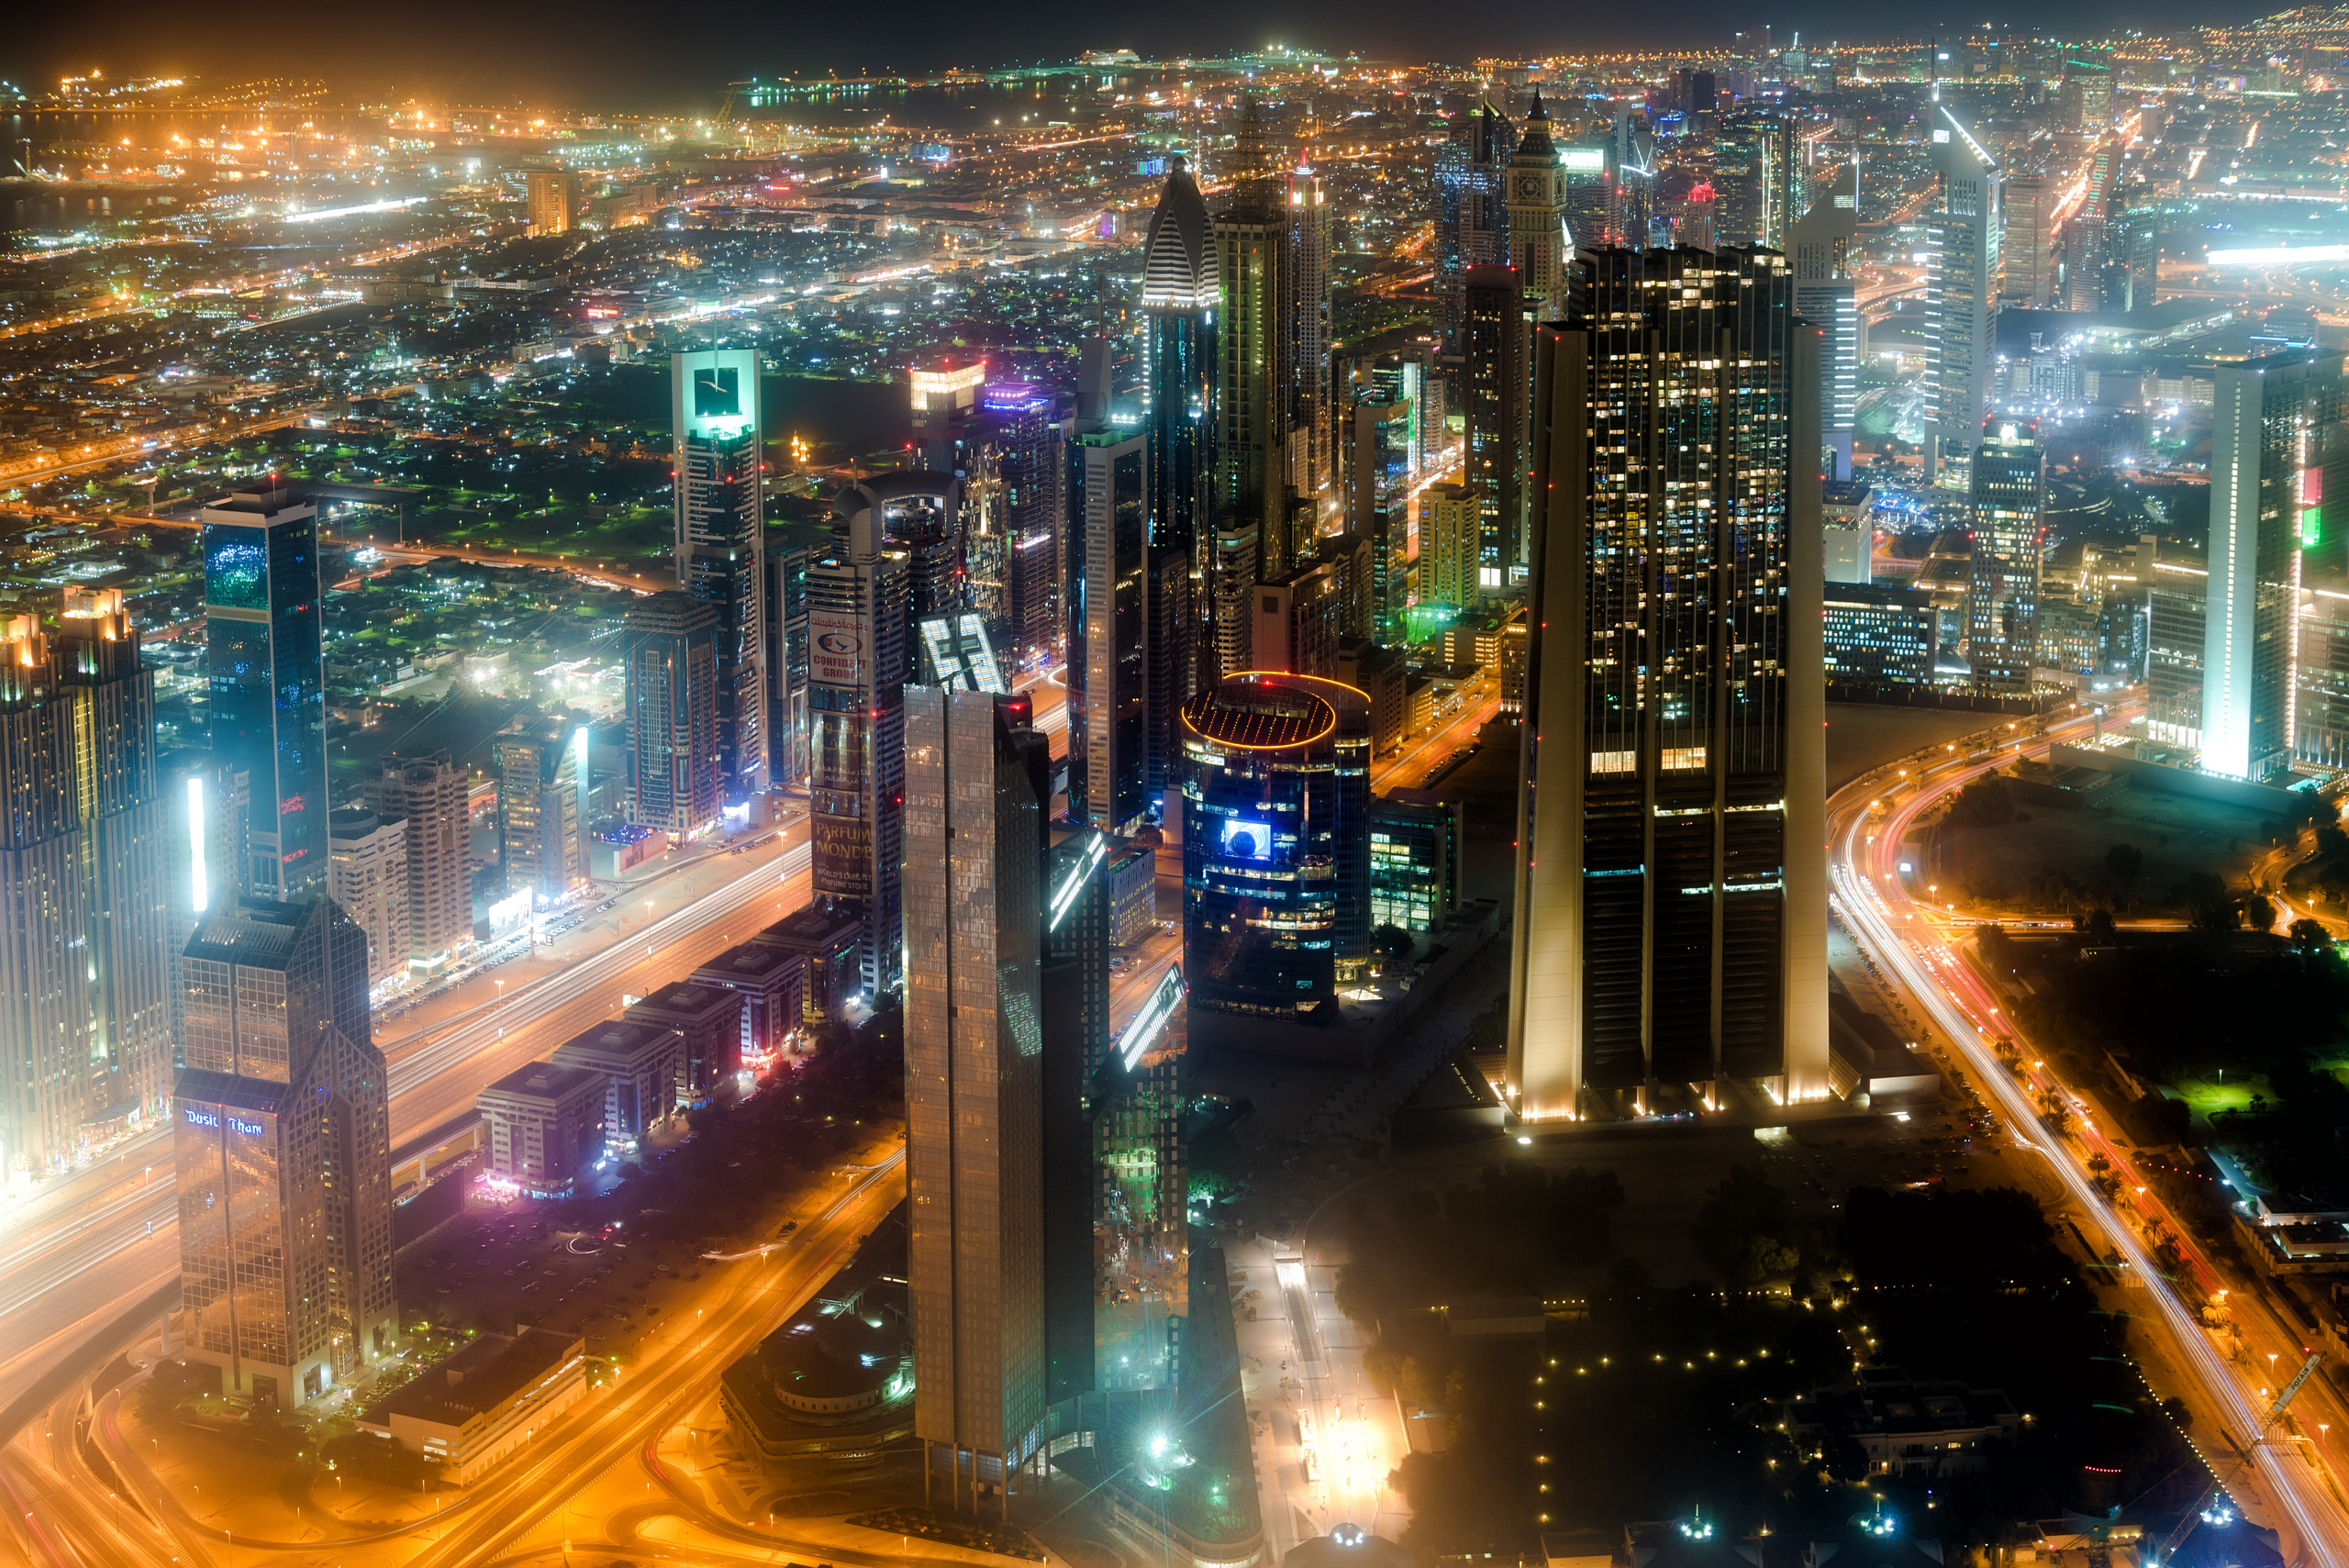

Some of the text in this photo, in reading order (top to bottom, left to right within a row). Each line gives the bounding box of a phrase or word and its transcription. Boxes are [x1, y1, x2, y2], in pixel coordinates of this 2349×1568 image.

[823, 667, 856, 679] GROUP
[817, 868, 842, 879] WORLD'S
[185, 1109, 262, 1137] Dusit Thani
[2291, 1367, 2310, 1390] POTAIN
